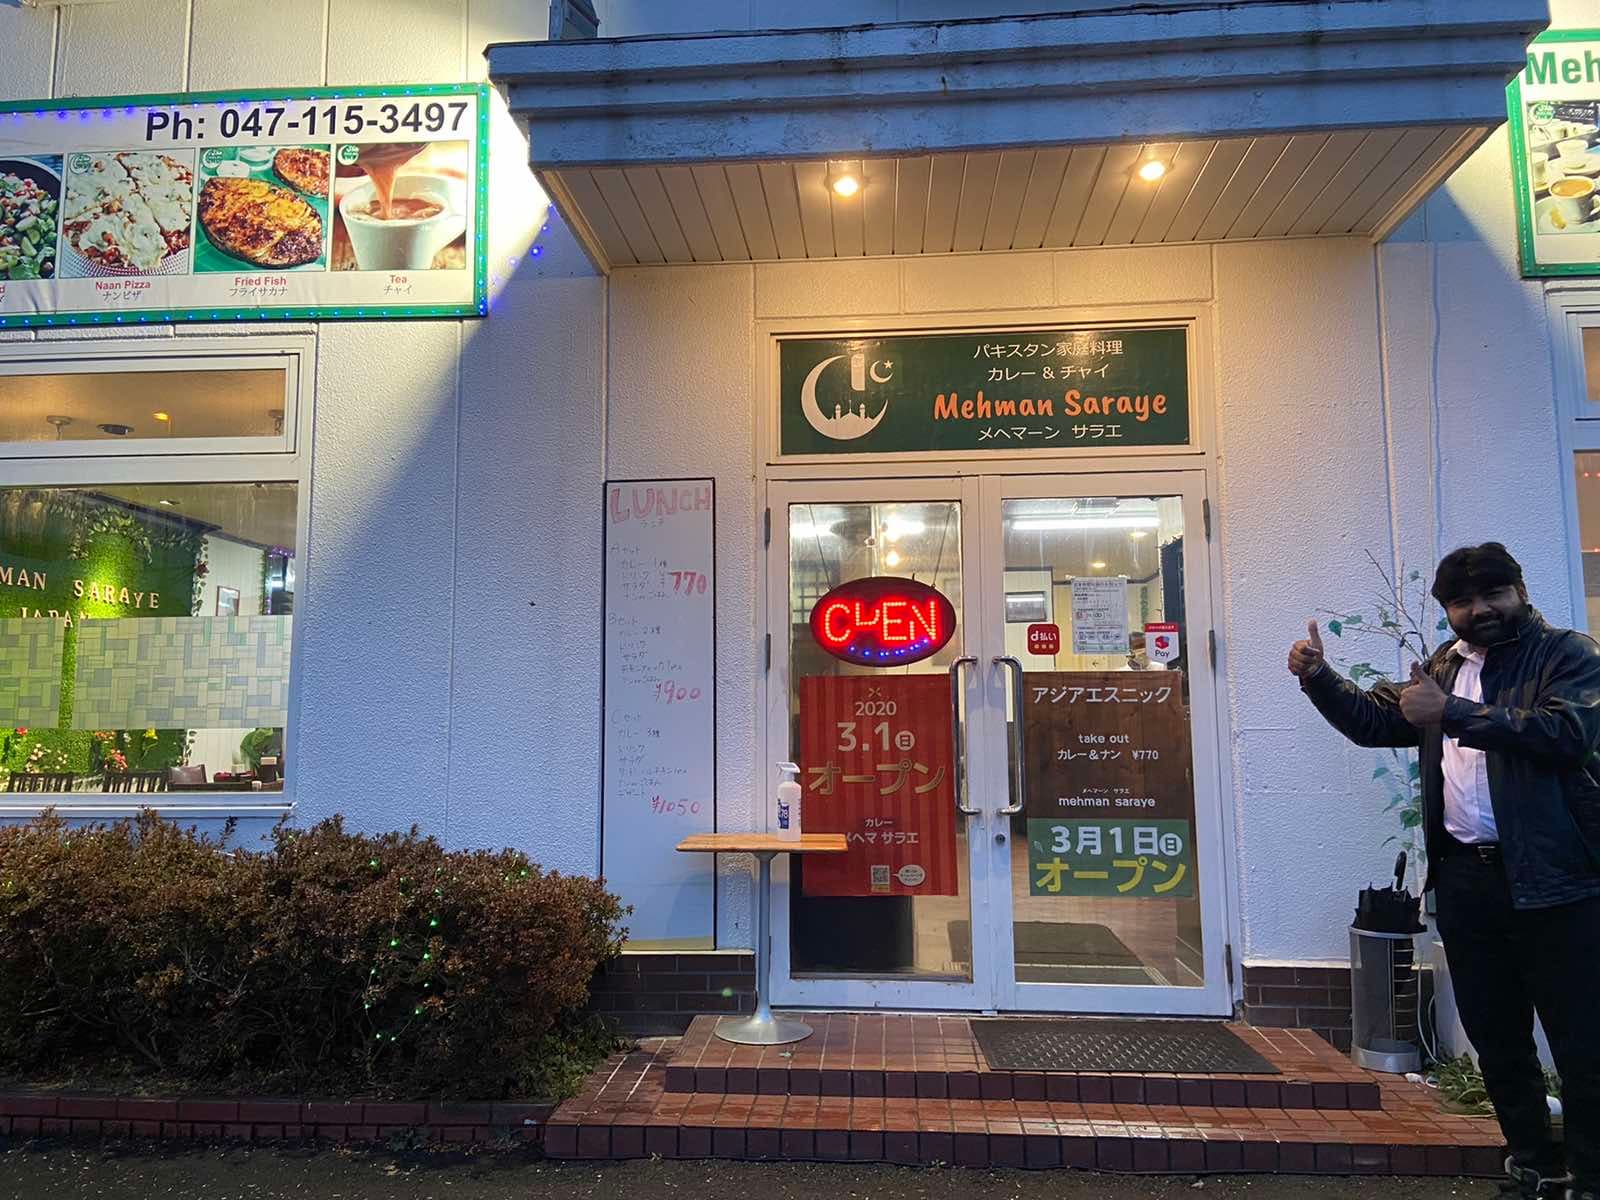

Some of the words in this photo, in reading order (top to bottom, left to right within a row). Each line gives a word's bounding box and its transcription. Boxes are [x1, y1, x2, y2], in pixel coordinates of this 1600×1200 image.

[145, 109, 205, 141] Ph:
[219, 101, 469, 139] 047-115-3497
[95, 281, 121, 291] Naan
[124, 280, 151, 290] Pizza
[234, 276, 261, 287] Fried
[264, 275, 287, 286] Fish
[390, 274, 408, 284] Tea
[229, 286, 288, 297] フライサカナ
[383, 284, 413, 296] チャイ
[973, 339, 1124, 359] パキスタン家庭料理
[987, 366, 1037, 382] カレー
[1042, 366, 1056, 381] &
[1060, 363, 1111, 381] チャイ
[933, 390, 1055, 421] Mehman
[1064, 388, 1168, 423] Saraye
[978, 425, 1060, 442] メヘマーン
[1072, 424, 1123, 439] サラエ
[610, 487, 711, 524] LUNCH
[73, 579, 160, 609] SARAYE
[1155, 649, 1170, 659] Pay
[1031, 686, 1172, 705] アジアエスニック
[855, 701, 897, 716] 2020
[1078, 734, 1105, 744] take
[1109, 734, 1130, 744] out
[1131, 750, 1159, 760] ¥770
[807, 759, 945, 797] オープン
[1058, 797, 1110, 807] mehman
[1115, 797, 1156, 808] saraye
[864, 817, 894, 829] カレー
[880, 831, 920, 845] サラエ
[1036, 856, 1186, 893] オープン
